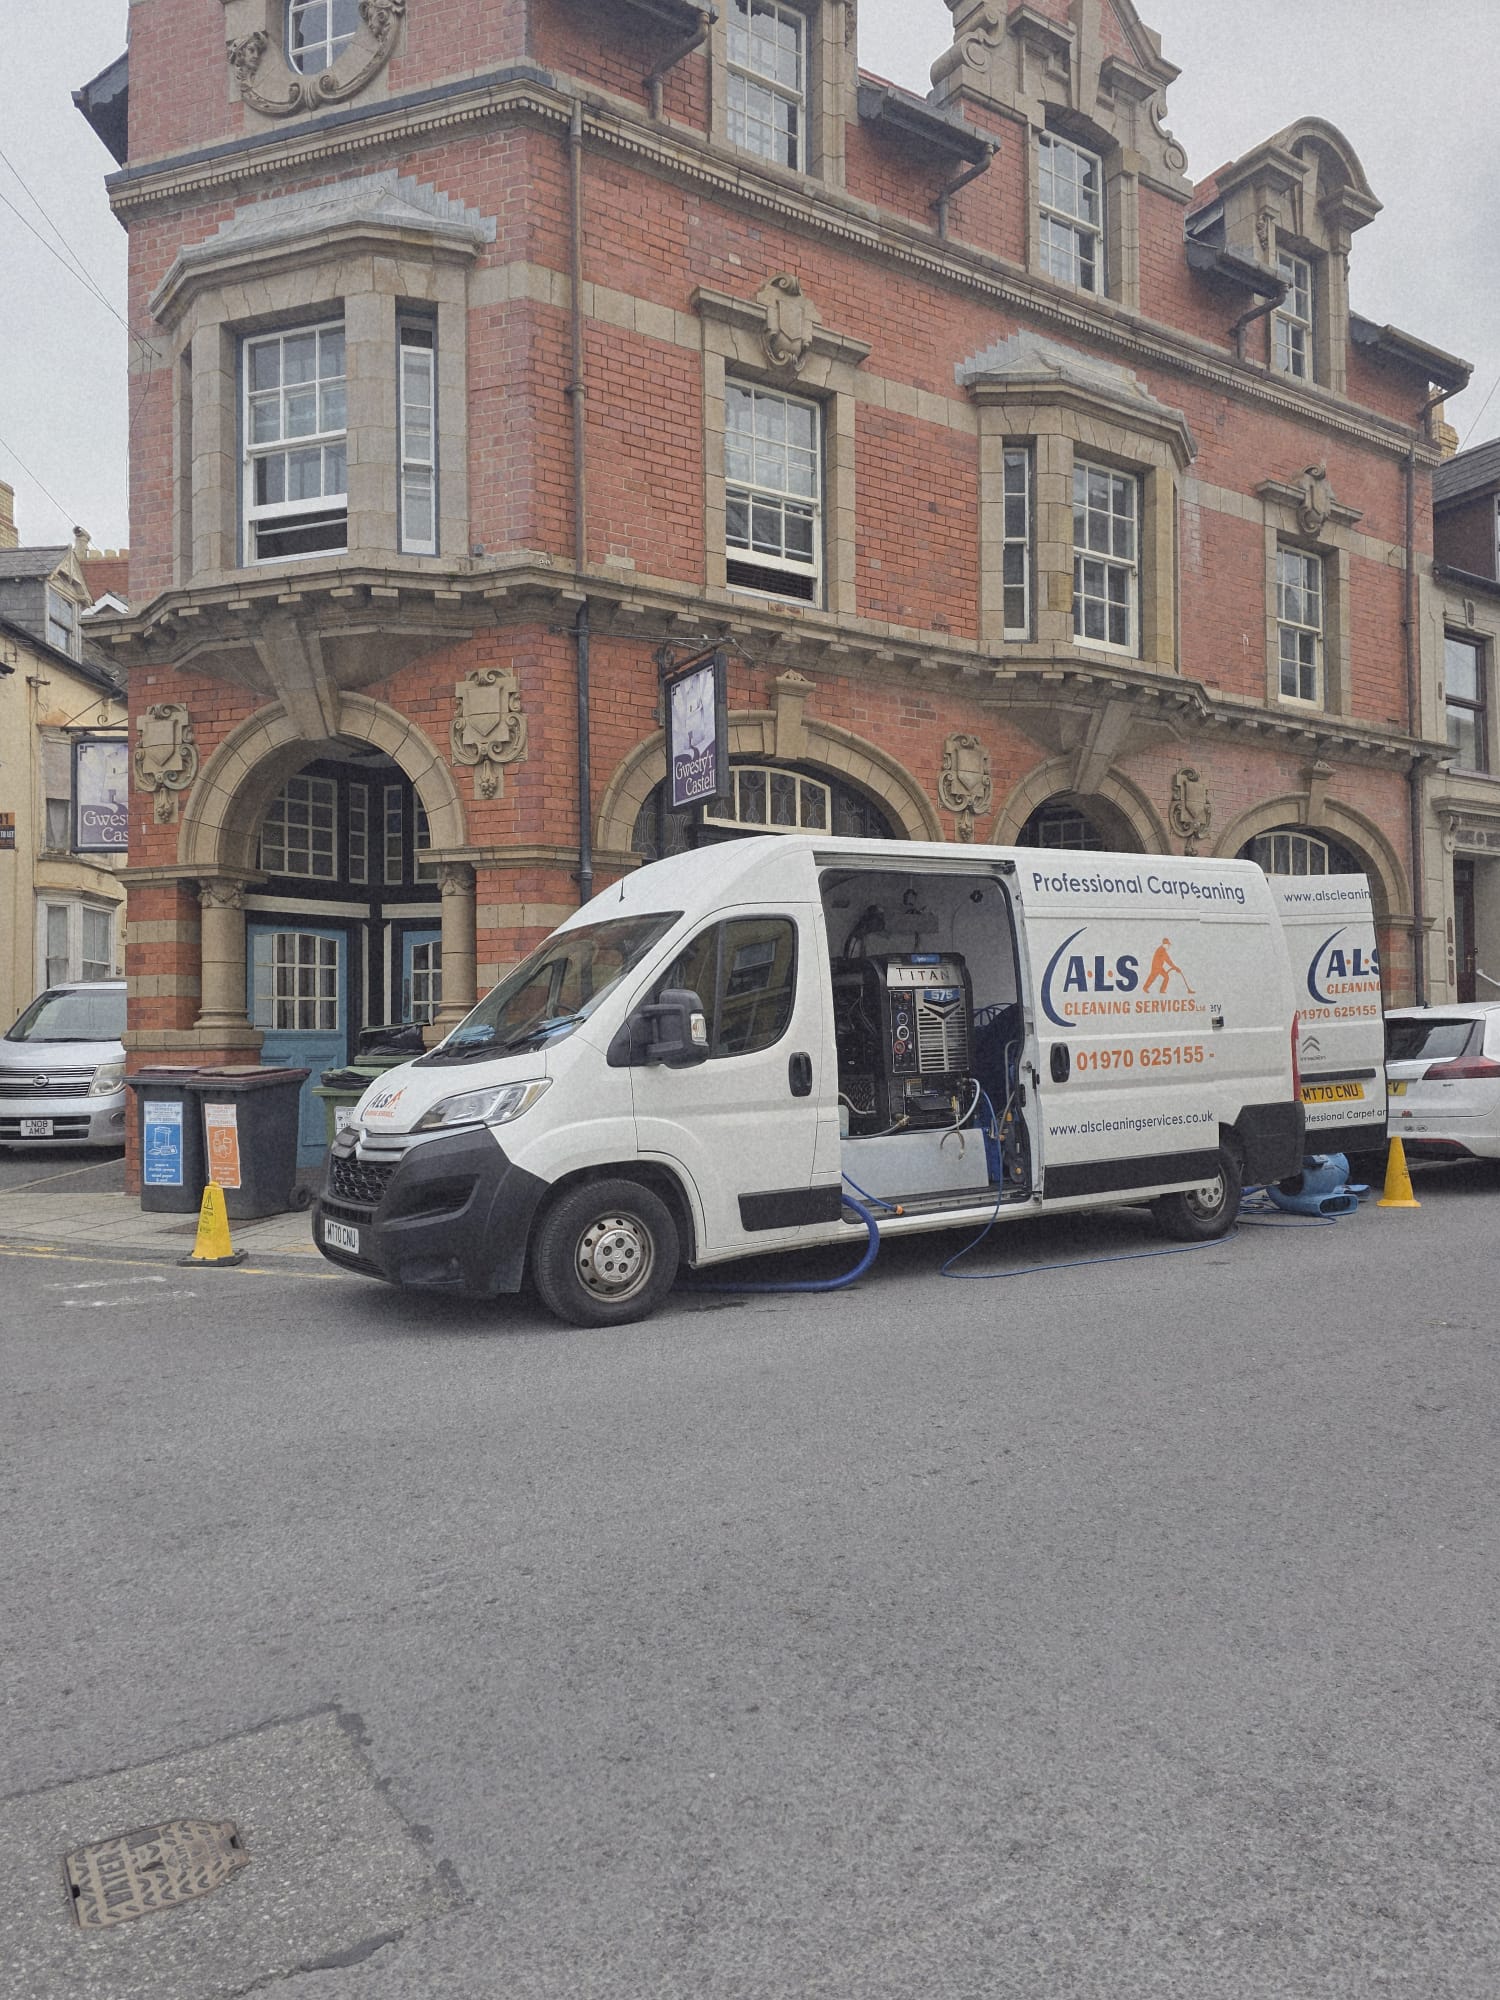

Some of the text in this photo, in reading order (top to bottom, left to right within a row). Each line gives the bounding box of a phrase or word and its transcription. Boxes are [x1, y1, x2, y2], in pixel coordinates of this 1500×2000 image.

[675, 750, 714, 780] Gwesty'r
[686, 769, 715, 796] Castell
[83, 810, 128, 826] Gwes
[1032, 872, 1143, 894] Professional
[896, 966, 950, 982] TITAN
[931, 988, 954, 1001] 575
[1064, 1001, 1131, 1016] CLEANING
[1135, 999, 1196, 1013] SERVICES
[1296, 1005, 1377, 1020] 01970 625155
[1076, 1050, 1134, 1071] 01970
[1139, 1045, 1204, 1067] 625155
[1302, 1084, 1359, 1101] MT70 CNU
[1049, 1110, 1215, 1136] www.alscleaningservices.co.uk
[1346, 1108, 1375, 1122] Carpet
[327, 1221, 342, 1244] MT70
[95, 1849, 134, 1909] WATER
